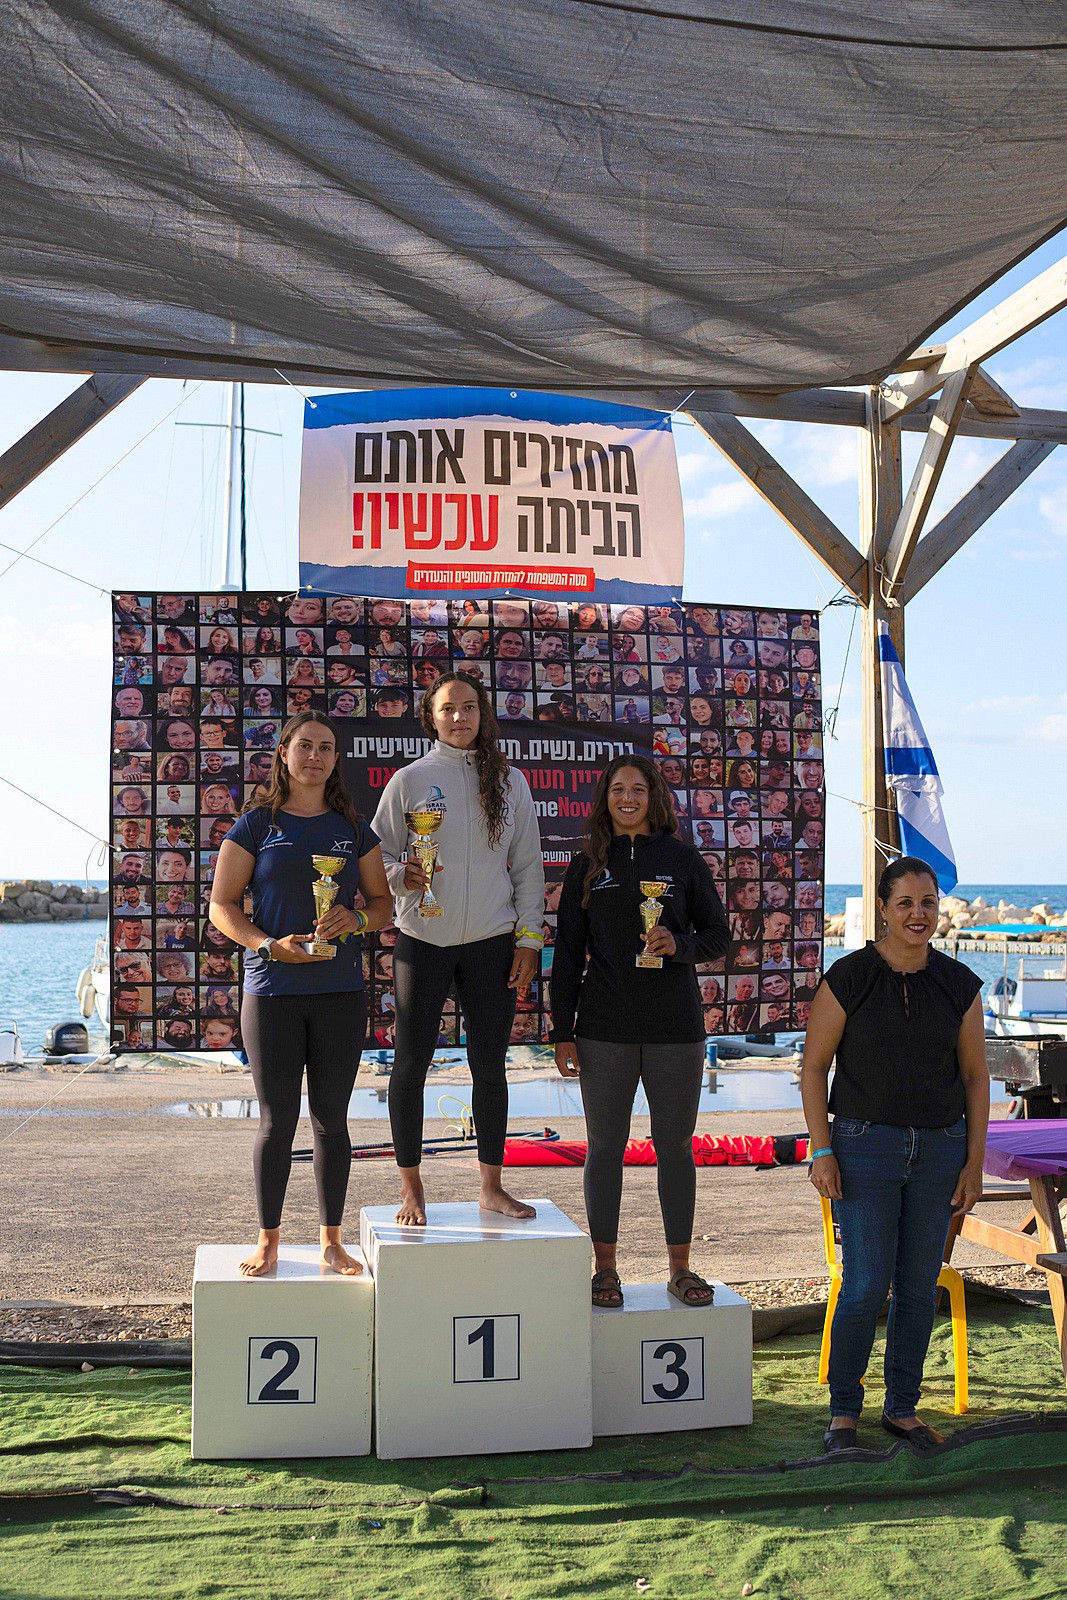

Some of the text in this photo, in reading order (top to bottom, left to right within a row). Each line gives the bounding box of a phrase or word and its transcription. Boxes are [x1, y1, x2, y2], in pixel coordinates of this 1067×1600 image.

[354, 428, 638, 496] מחזירים אותם
[352, 492, 643, 558] הביתה עכשיו!
[413, 569, 588, 587] מטה המשפחות להחזרת החטופים והנעדרים
[257, 1340, 300, 1401] 2
[467, 1318, 495, 1379] 1
[652, 1342, 690, 1400] 3
